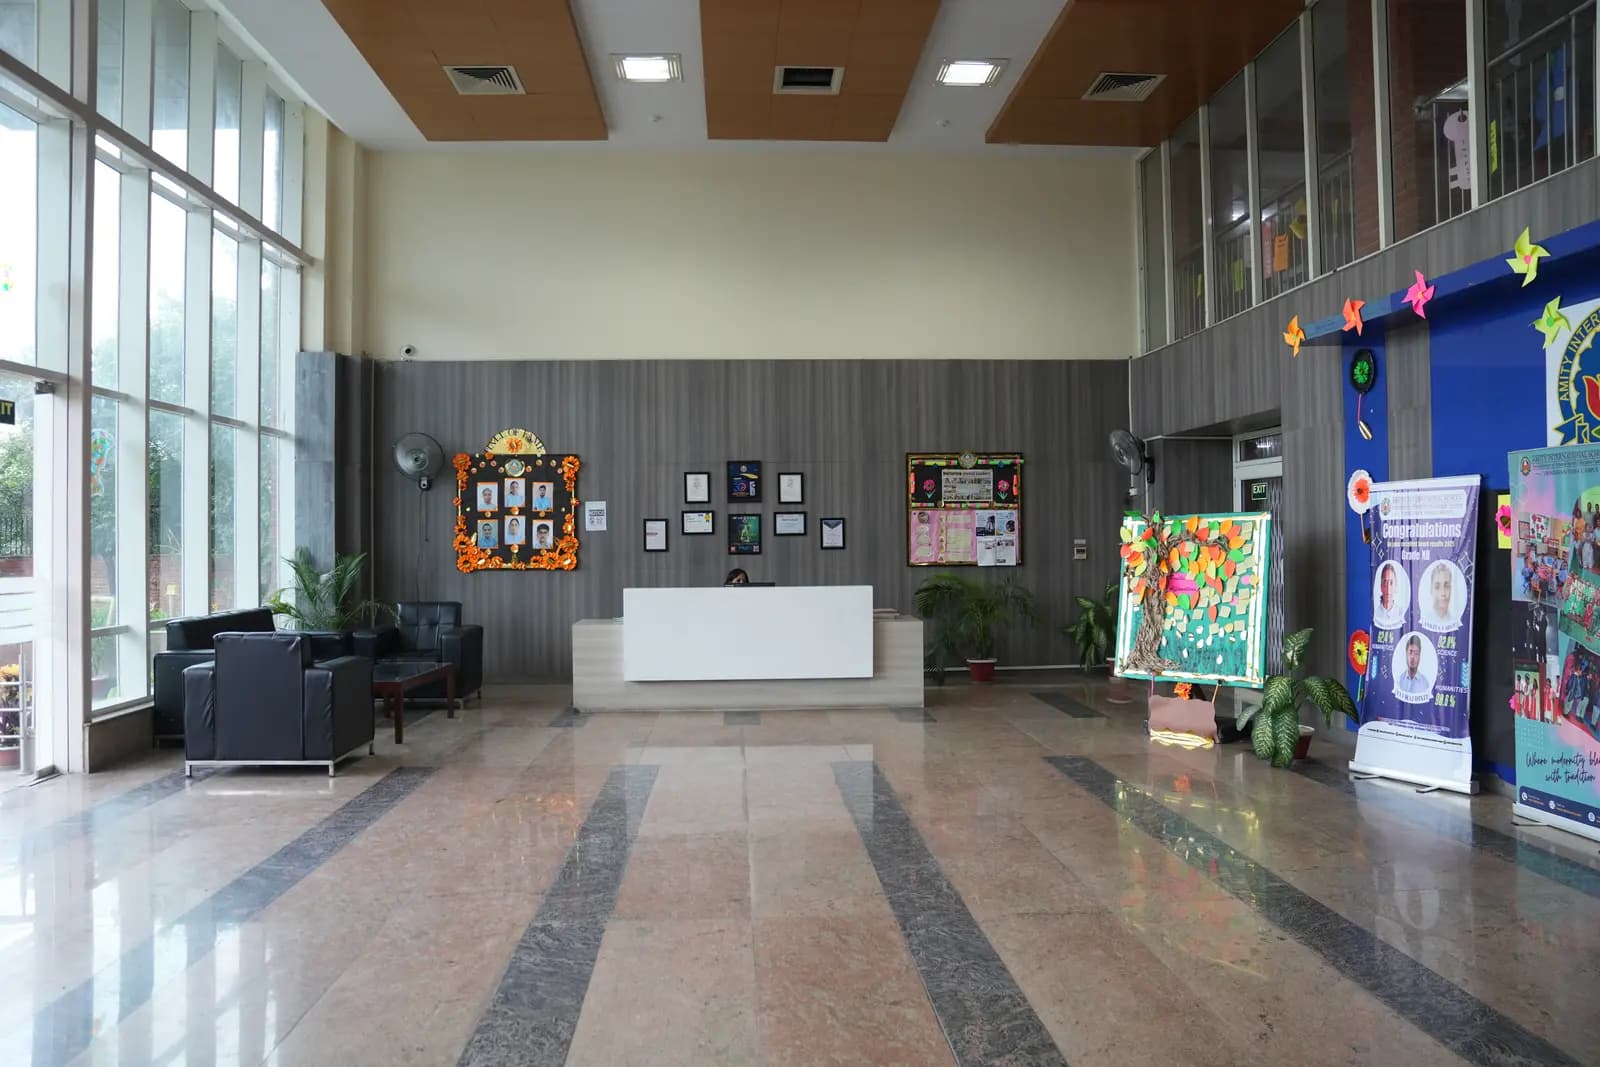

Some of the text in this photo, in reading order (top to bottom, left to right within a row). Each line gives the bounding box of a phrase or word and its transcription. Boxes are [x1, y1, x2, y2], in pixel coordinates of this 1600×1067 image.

[1559, 355, 1573, 401] AMITY
[1253, 484, 1266, 494] EXIT
[1383, 522, 1462, 540] Congratulations
[1437, 649, 1458, 657] SCIENCE
[1435, 685, 1470, 694] HUMANITIES
[1564, 768, 1596, 784] tradition
